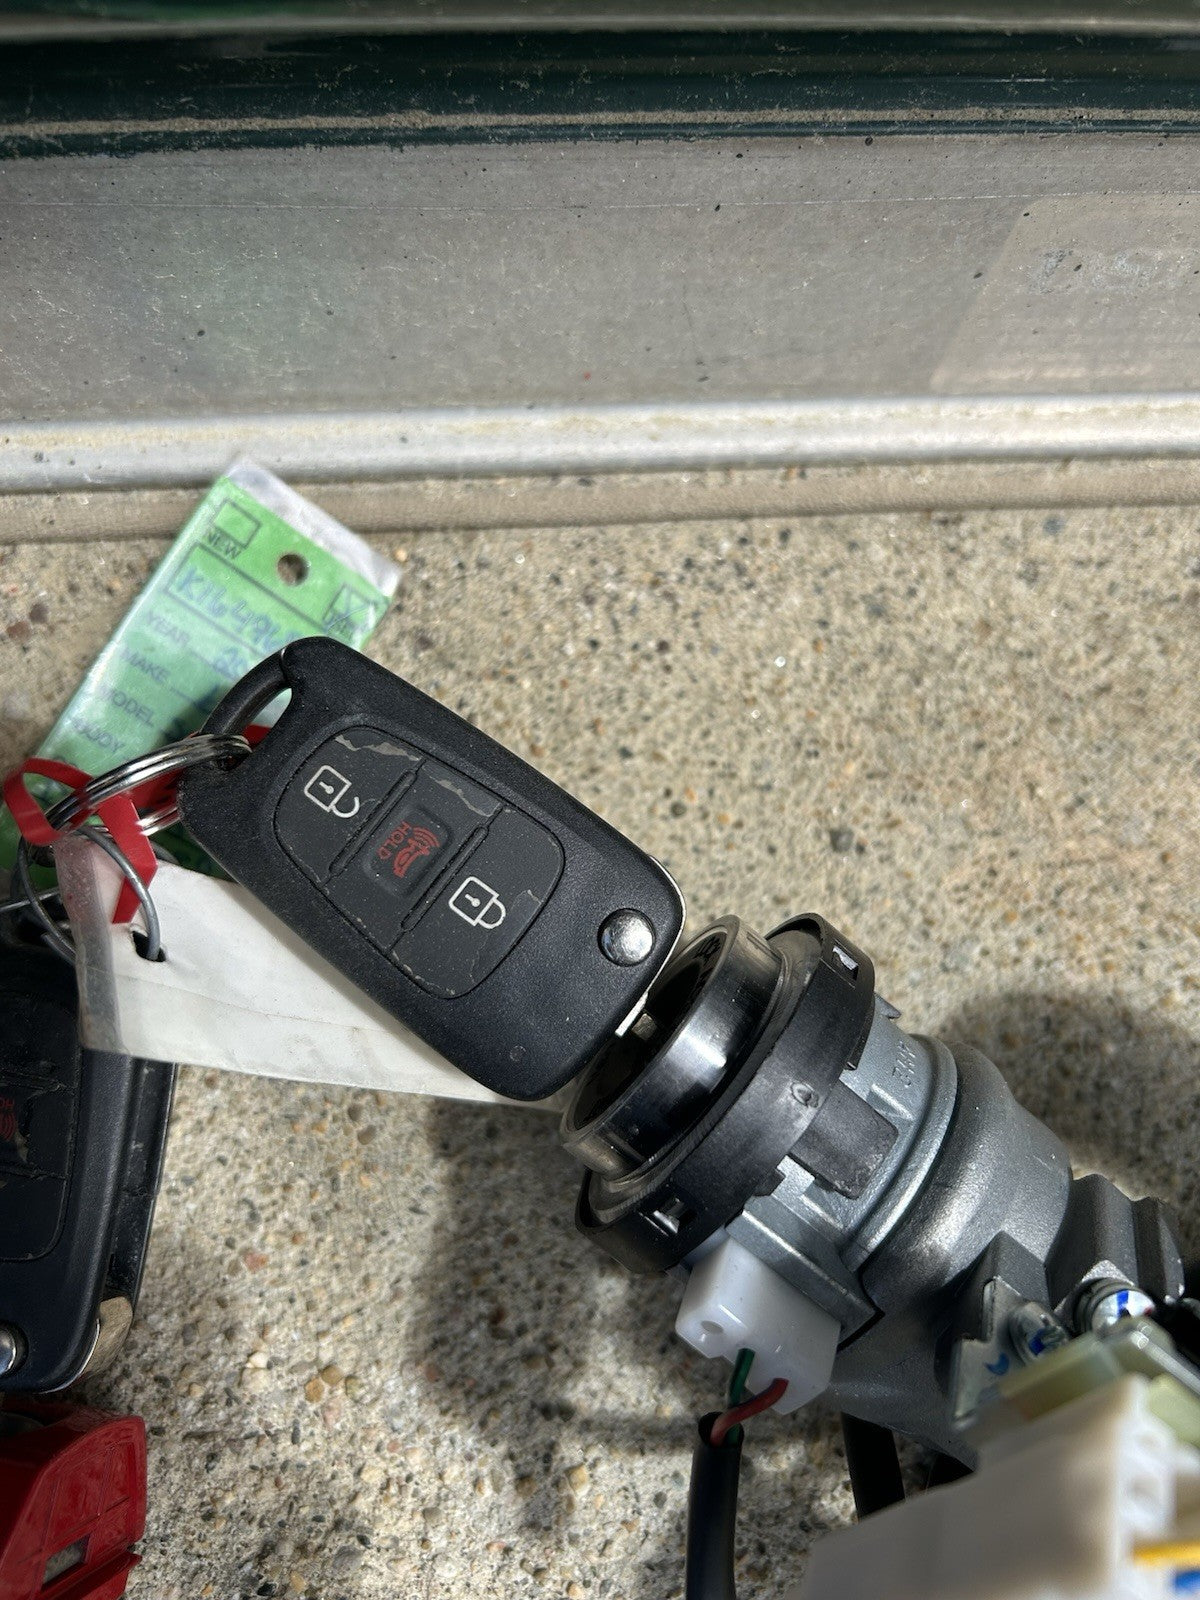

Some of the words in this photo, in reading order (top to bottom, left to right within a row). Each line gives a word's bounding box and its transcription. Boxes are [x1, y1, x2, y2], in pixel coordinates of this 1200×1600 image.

[206, 530, 242, 560] NEW
[145, 611, 192, 648] YEAR
[376, 820, 412, 860] HOLD
